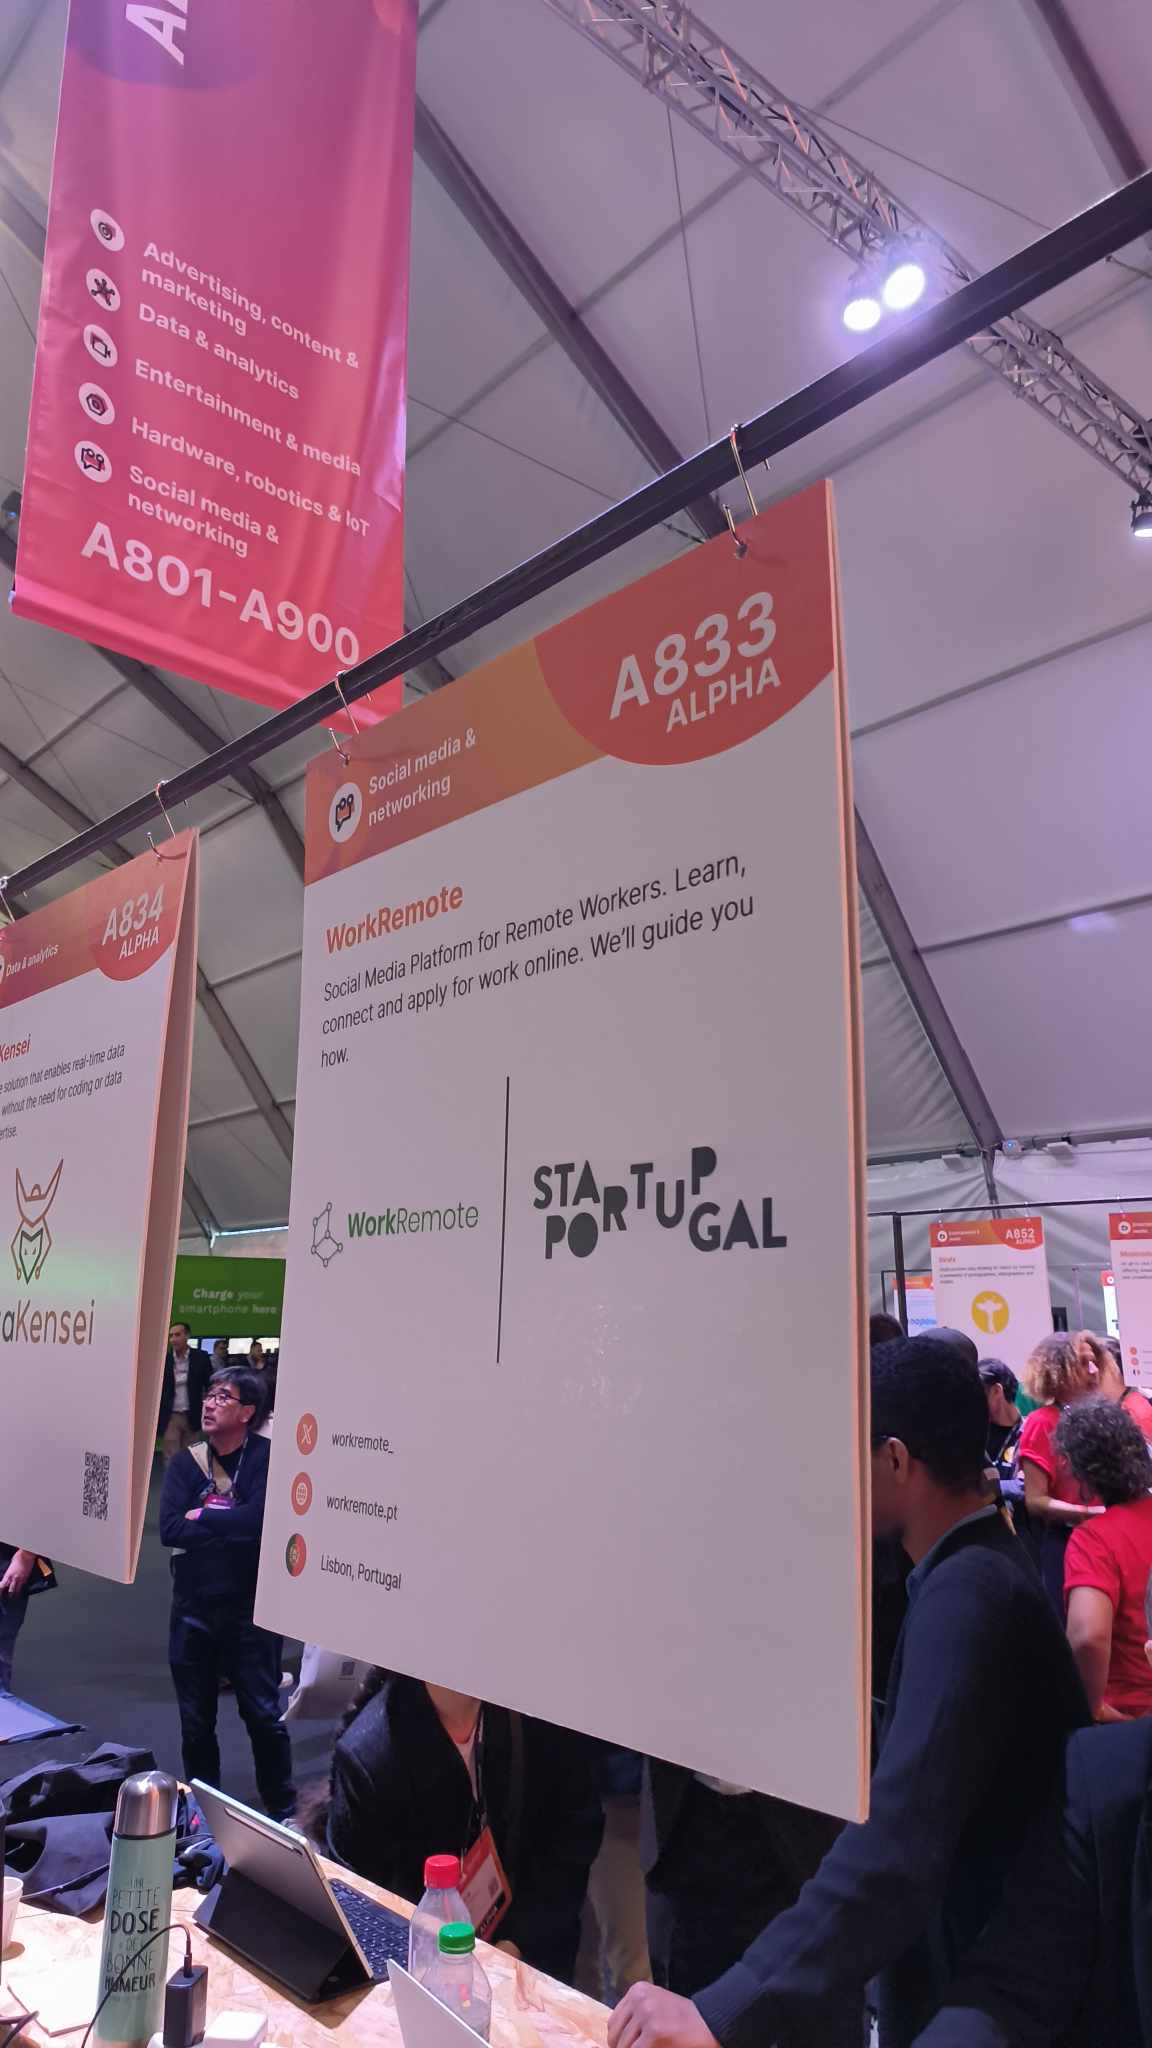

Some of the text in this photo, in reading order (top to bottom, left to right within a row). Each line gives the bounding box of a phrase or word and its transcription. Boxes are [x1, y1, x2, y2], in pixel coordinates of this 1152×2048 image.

[142, 268, 247, 336] marketing
[144, 242, 358, 368] Advertising, content &
[139, 303, 299, 399] Data & analytics
[135, 358, 360, 476] Entertainment & media
[129, 464, 279, 545] Social media &
[132, 417, 370, 536] Hardware, robotics & IoT
[128, 492, 248, 558] networking
[81, 521, 359, 665] A801-A900
[609, 591, 777, 720] A833
[666, 657, 781, 733] ALPHA
[368, 727, 476, 794] Social media &
[368, 775, 450, 827] networking
[101, 884, 165, 946] A834
[119, 926, 160, 960] ALPHA
[324, 855, 745, 1002] Social Media Platform for Remote Workers. Learn,
[326, 886, 464, 954] WorkRemote
[6, 962, 21, 977] Data
[28, 944, 59, 966] analytics
[322, 896, 753, 1035] connect and apply for work online. We'll guide you
[4, 1075, 28, 1093] solution
[30, 1070, 43, 1085] that
[44, 1061, 71, 1080] enables
[72, 1050, 105, 1071] real-time
[106, 1044, 125, 1061] data
[321, 1048, 349, 1068] how.
[26, 1096, 37, 1109] the
[38, 1088, 56, 1105] need
[57, 1086, 68, 1102] for
[68, 1079, 93, 1098] coding
[94, 1077, 104, 1090] or
[104, 1071, 123, 1088] data
[348, 1202, 479, 1238] WorkRemote
[0, 1299, 95, 1345] aKensei
[193, 1288, 233, 1301] Charge
[332, 1432, 394, 1454] workremote_
[326, 1495, 398, 1523] workremote.pt
[320, 1554, 401, 1592] Lisbon, Portugal
[110, 1909, 159, 1935] DOSE
[112, 1887, 160, 1908] PETITE
